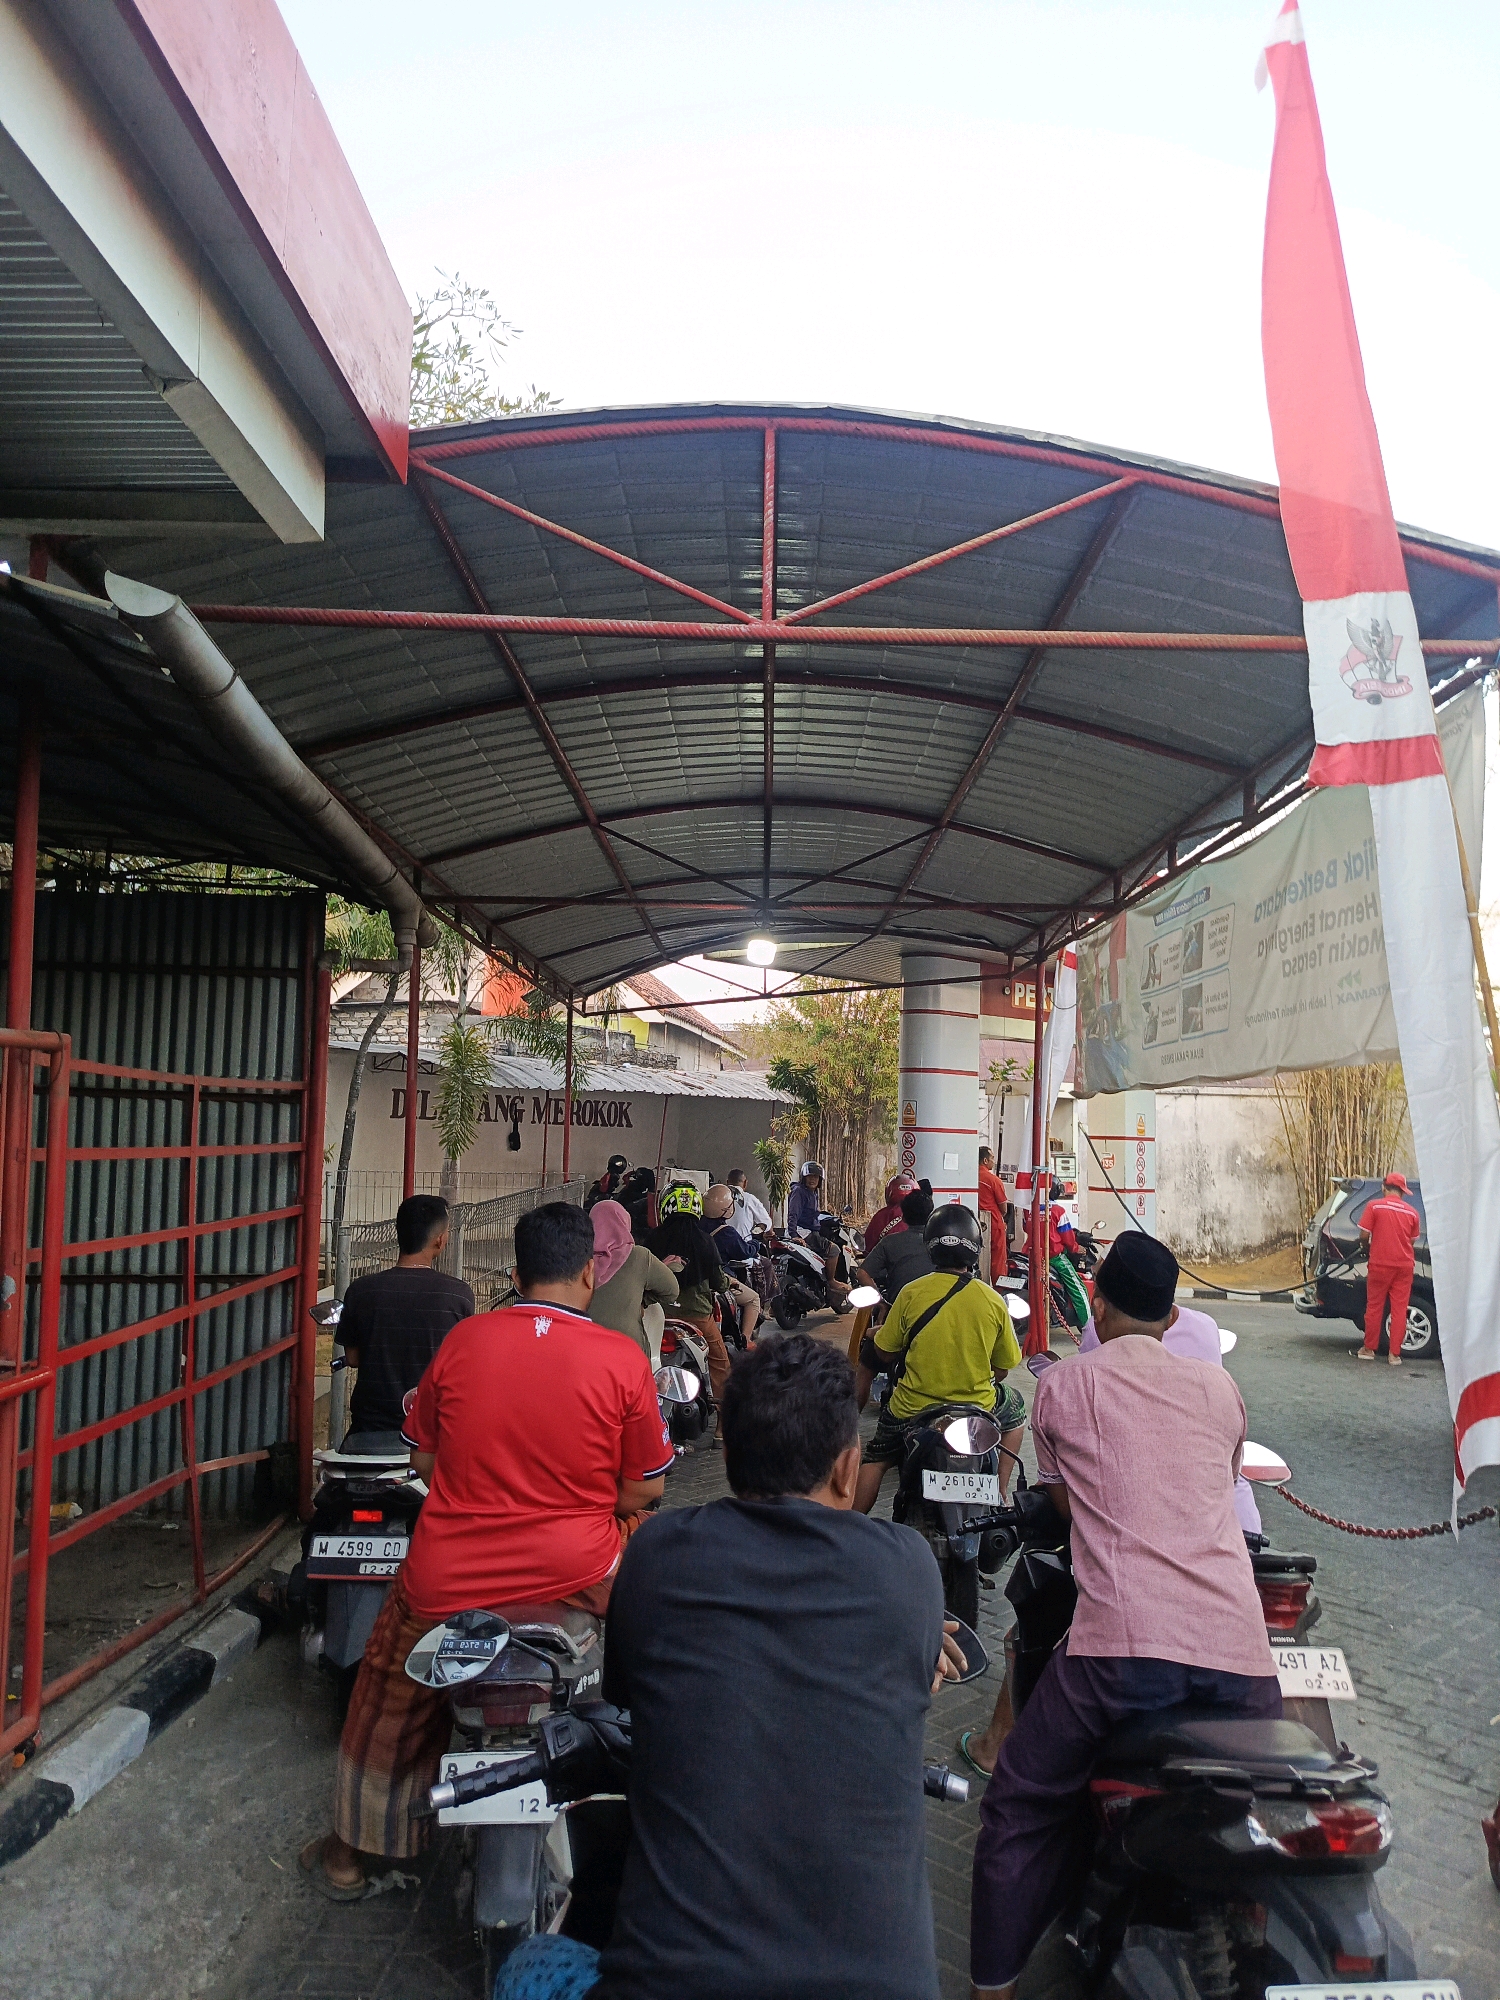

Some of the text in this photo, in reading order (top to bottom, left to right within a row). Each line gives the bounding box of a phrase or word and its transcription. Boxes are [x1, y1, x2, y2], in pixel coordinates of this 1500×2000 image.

[530, 1096, 634, 1128] MEROKOK
[929, 1473, 993, 1489] M 2616 VY
[319, 1541, 401, 1557] M 4599 CD
[1320, 1653, 1341, 1673] AZ
